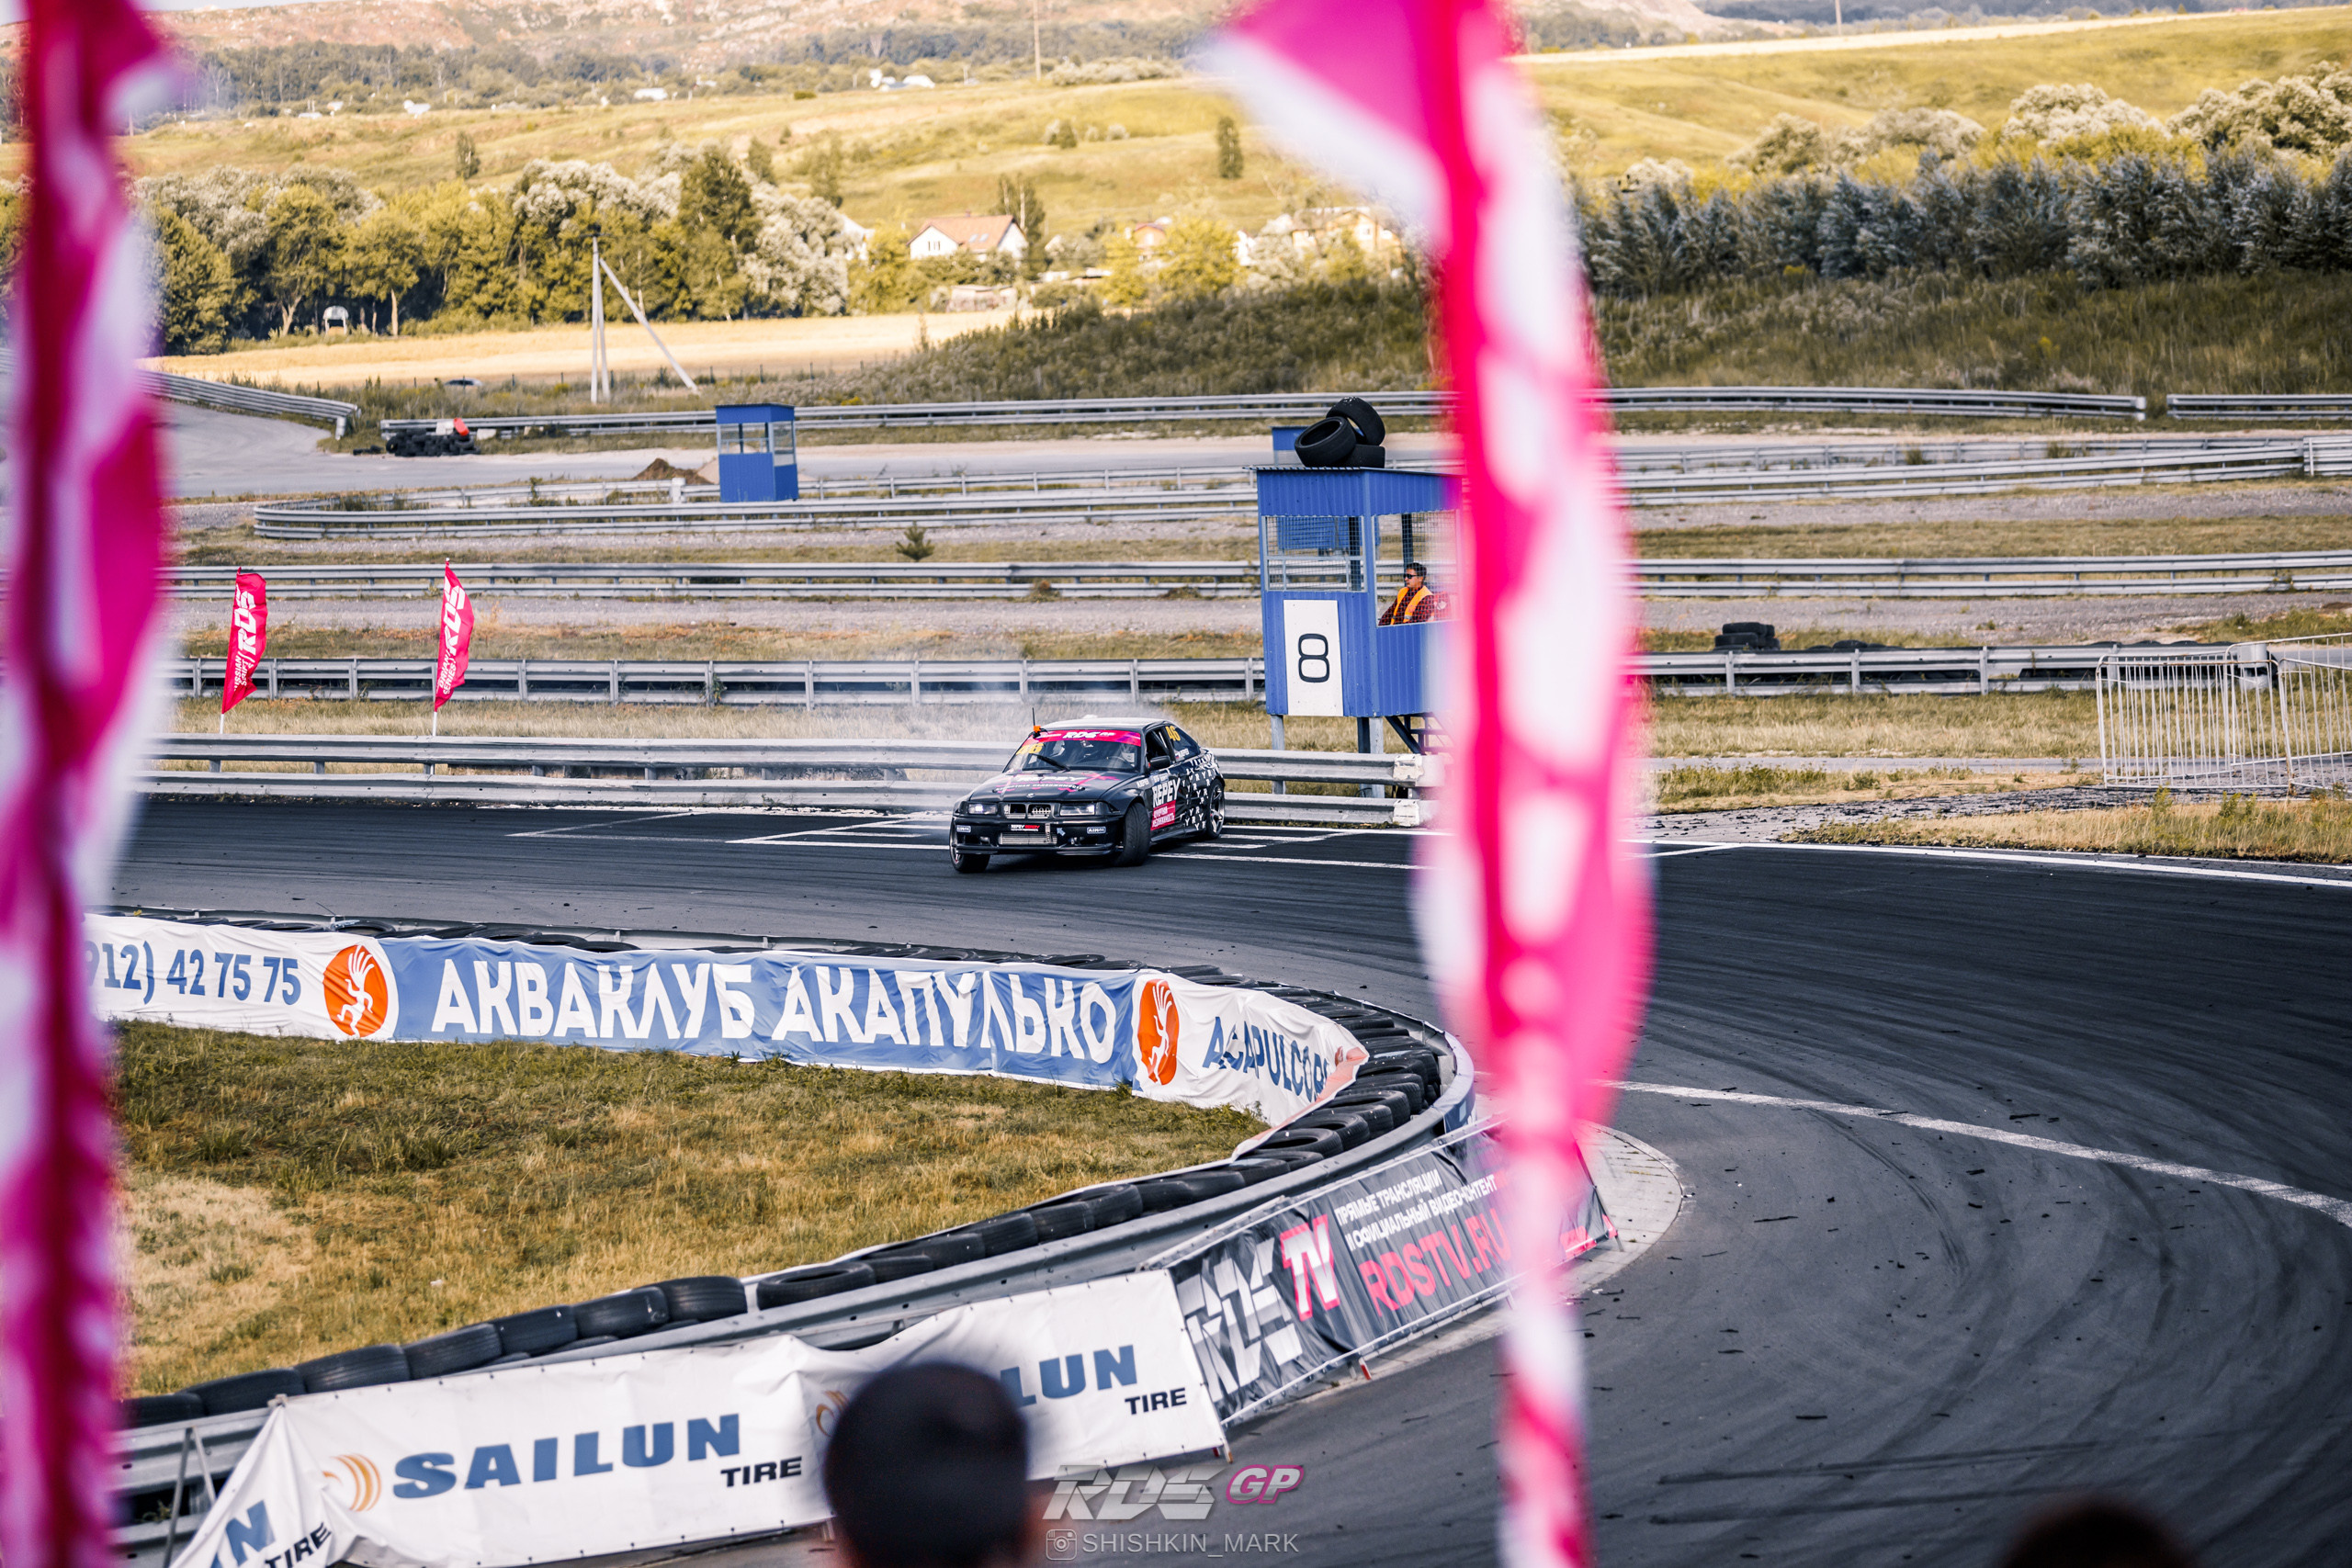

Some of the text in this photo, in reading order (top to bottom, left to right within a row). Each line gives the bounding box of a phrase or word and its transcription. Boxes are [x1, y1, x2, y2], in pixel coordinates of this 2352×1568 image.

[1297, 633, 1330, 683] 8
[1165, 725, 1182, 741] 46
[1151, 777, 1182, 808] REPEY
[166, 949, 206, 996] 42
[214, 952, 252, 1001] 75
[263, 956, 301, 1006] 75
[431, 958, 1116, 1064] АКВАКЛУБ АКАПУЛЬКО
[1333, 1168, 1443, 1226] ПРЯМЫЕ ТРАНСЛЯЦИИ
[1352, 1199, 1432, 1247] ОФИЦИАЛЬНЫЙ
[1357, 1208, 1512, 1317] RDSTV.RU
[1124, 1387, 1188, 1415] TIRE
[392, 1413, 741, 1499] SAILUN
[719, 1456, 803, 1487] TIRE
[265, 1522, 332, 1568] TIRE
